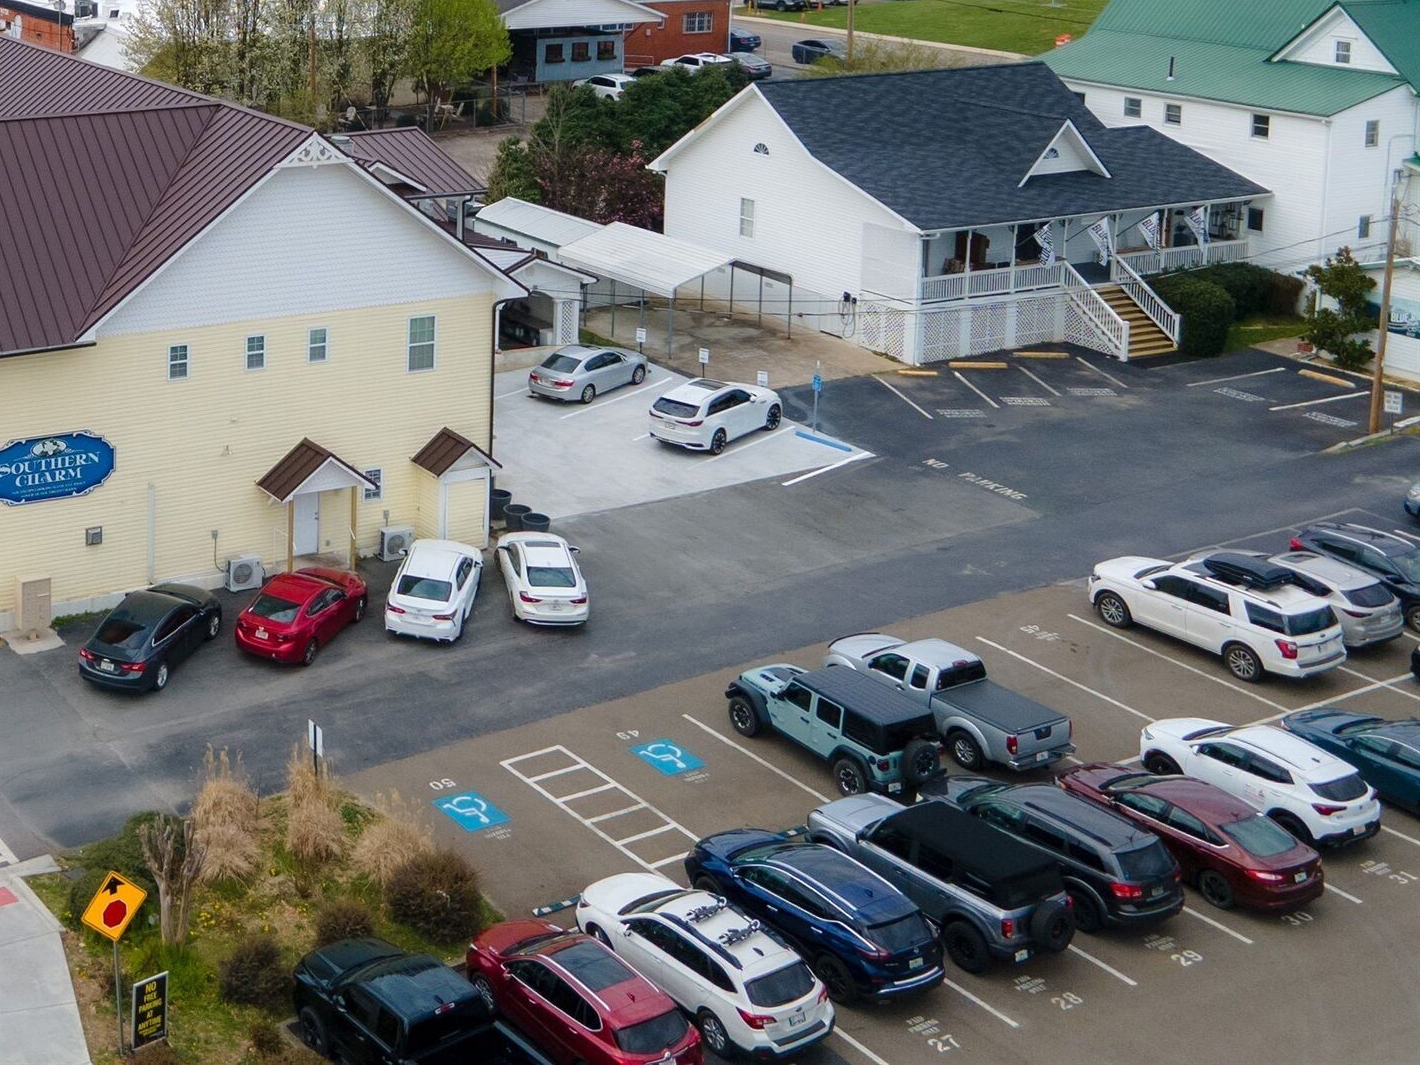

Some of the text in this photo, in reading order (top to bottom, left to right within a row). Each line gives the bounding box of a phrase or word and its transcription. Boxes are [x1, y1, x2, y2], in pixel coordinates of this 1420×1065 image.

[15, 467, 83, 487] CHARM
[922, 458, 1028, 500] NO PARKING
[616, 730, 640, 740] 49
[429, 778, 457, 790] 50
[1388, 871, 1418, 884] 31
[1280, 911, 1314, 926] 30
[1171, 950, 1203, 967] 29
[145, 981, 157, 993] NO
[138, 997, 163, 1014] PARKING
[1050, 992, 1083, 1010] 28
[146, 1009, 154, 1019] AT
[927, 1034, 960, 1052] 27
